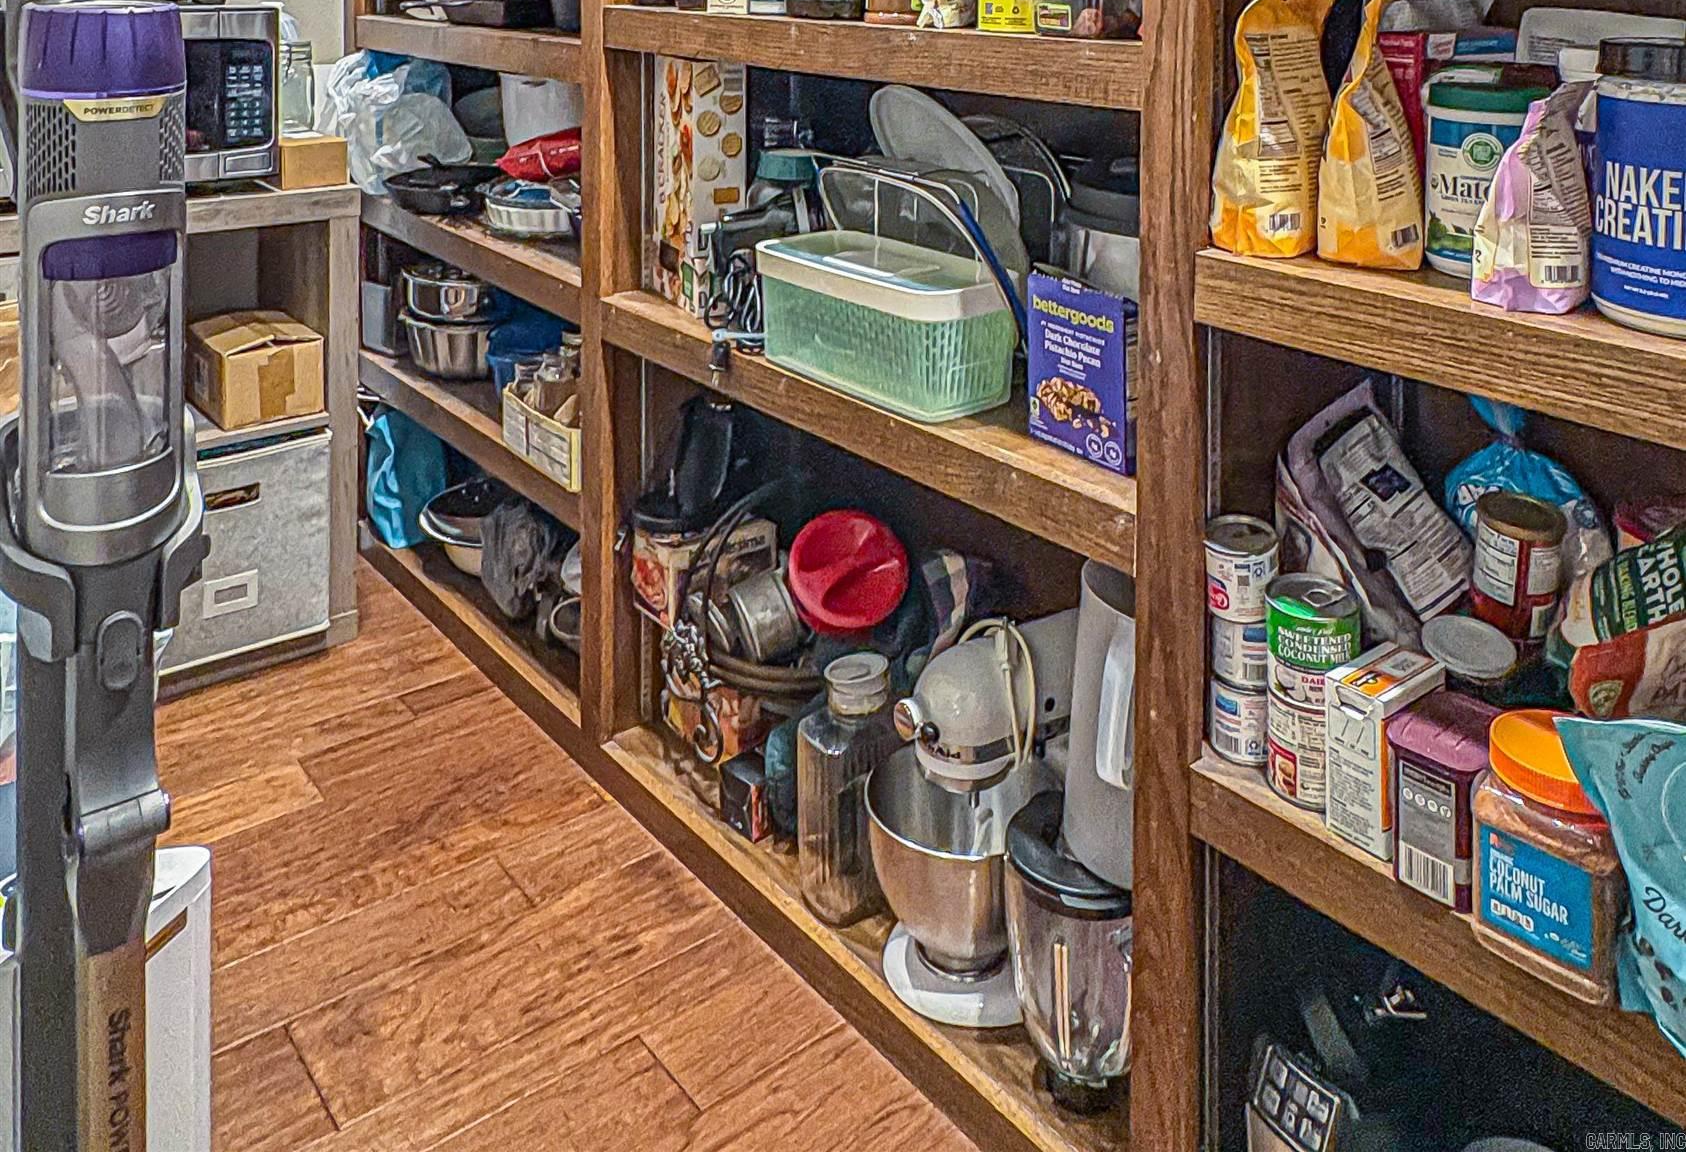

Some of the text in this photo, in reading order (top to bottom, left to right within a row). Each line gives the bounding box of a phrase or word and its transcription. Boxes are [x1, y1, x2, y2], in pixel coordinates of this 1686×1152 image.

[83, 104, 155, 116] POWERDETECT
[1606, 161, 1686, 211] NAKE
[82, 200, 156, 225] Shark
[1595, 194, 1686, 251] CREATI
[1033, 294, 1114, 333] bettergoods
[1278, 625, 1352, 644] SWEETENED
[1278, 635, 1352, 654] CONDENSED
[1278, 644, 1327, 664] COCONUT
[1489, 854, 1546, 897] COCONUT
[1489, 871, 1569, 926] PALM SUGAR
[1643, 885, 1686, 944] Dar
[108, 1089, 131, 1152] POW
